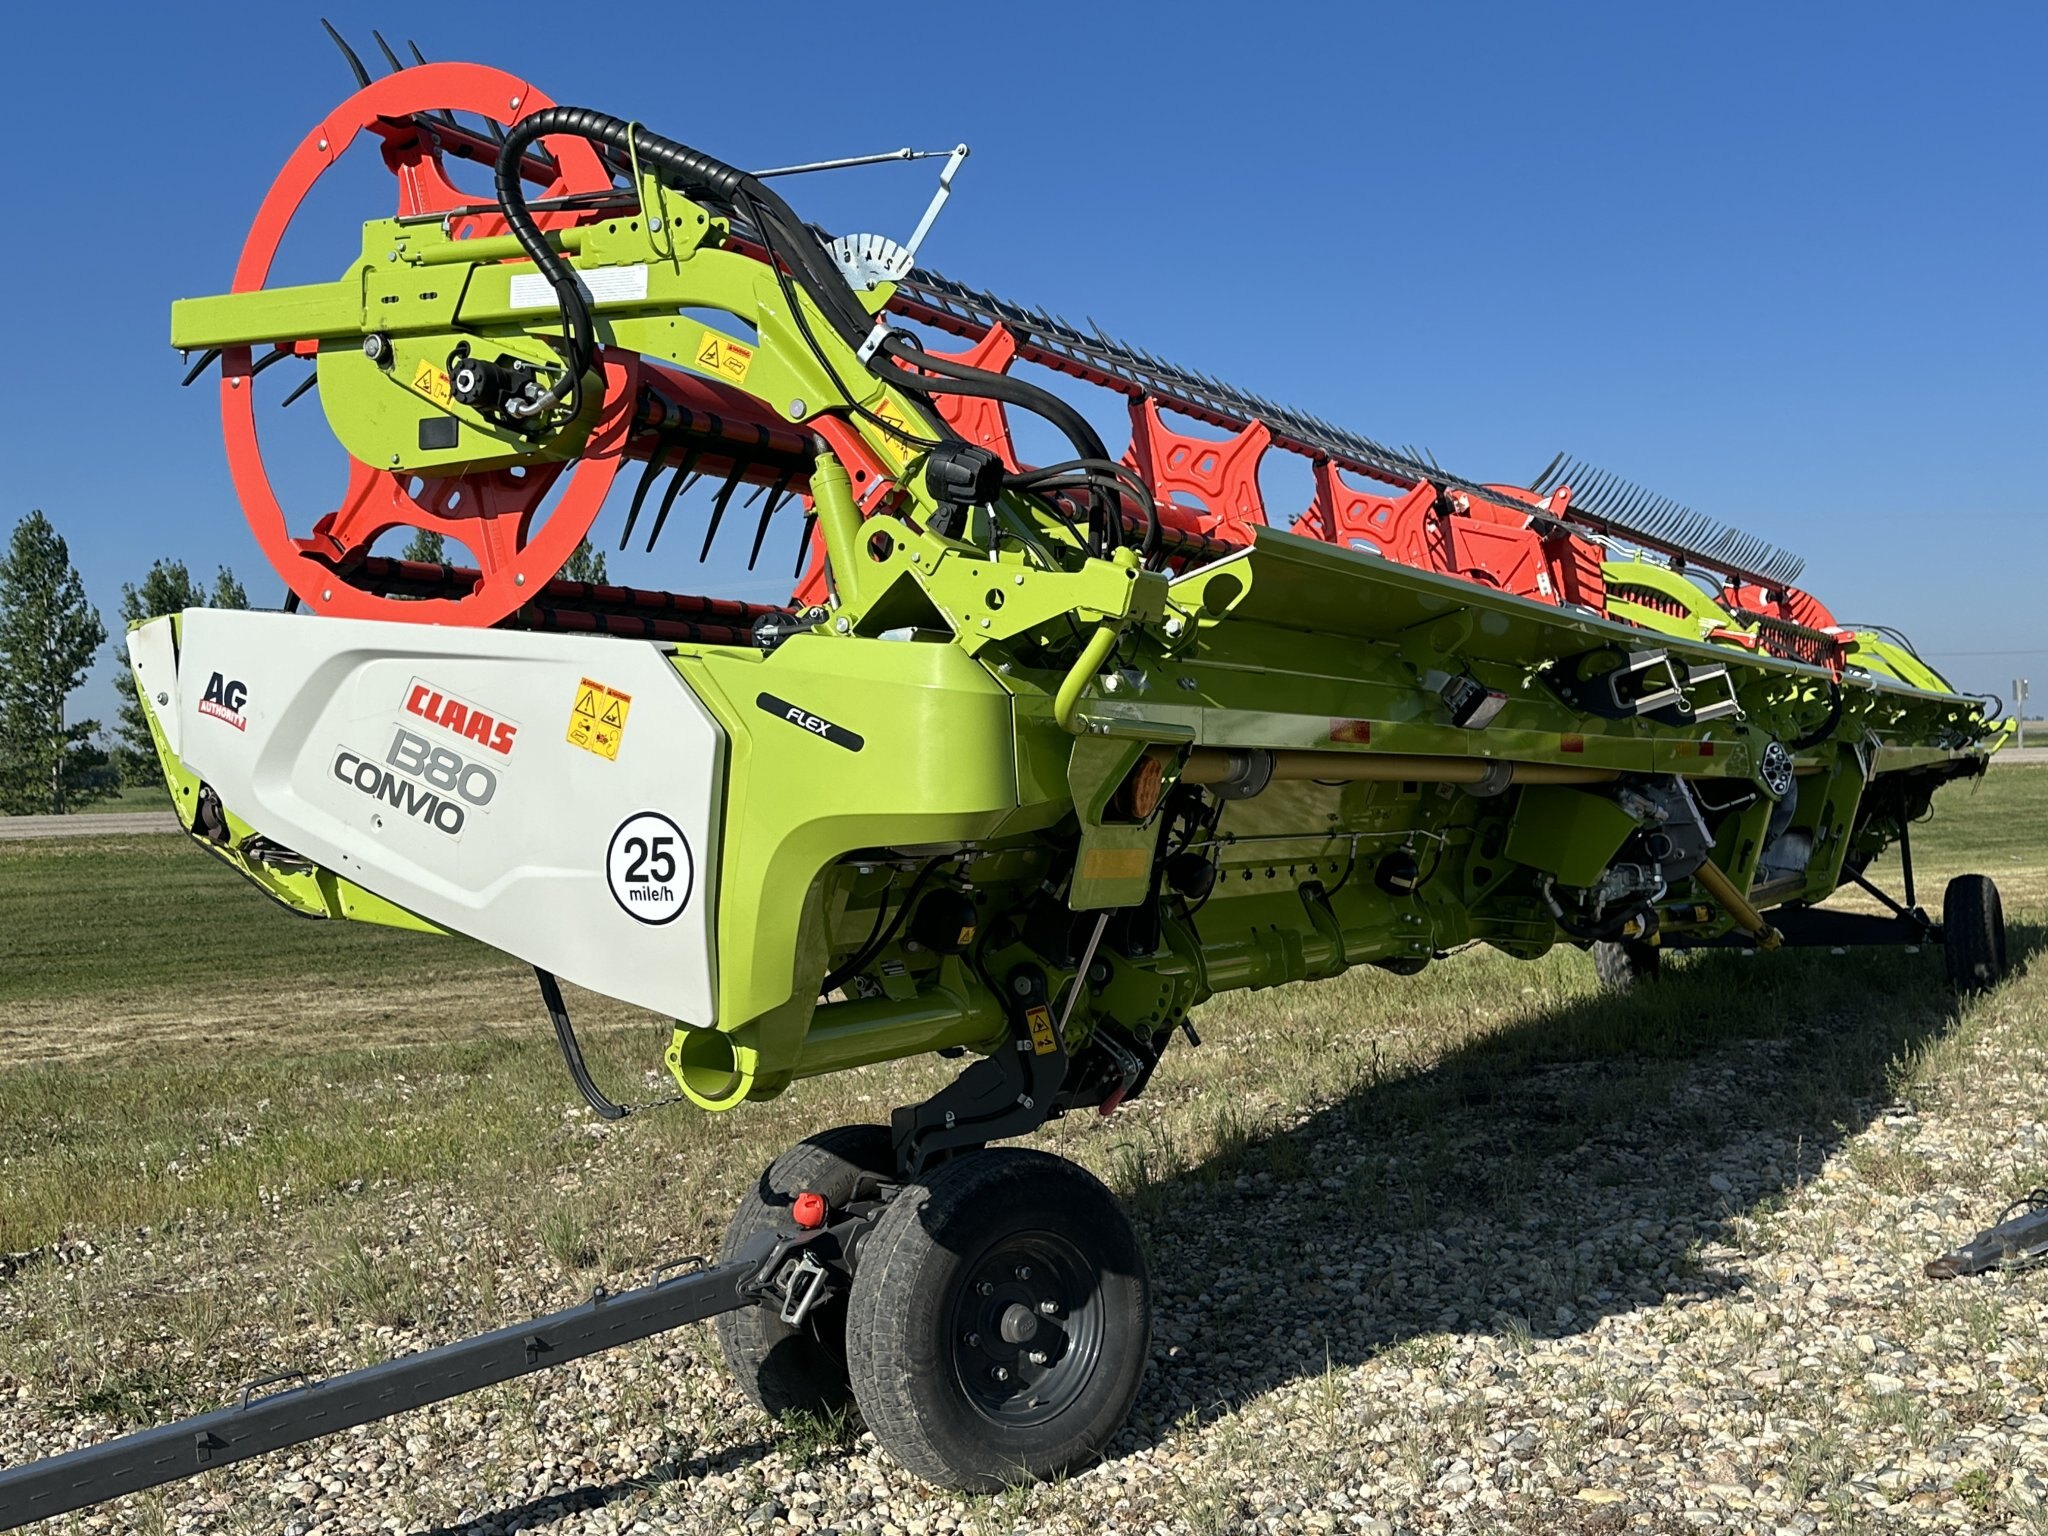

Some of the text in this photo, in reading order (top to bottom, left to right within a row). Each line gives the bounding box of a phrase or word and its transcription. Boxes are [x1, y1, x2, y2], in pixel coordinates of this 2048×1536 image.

[200, 701, 246, 728] AUTHORITY
[203, 670, 248, 714] AG
[405, 684, 518, 755] CLAAS
[785, 707, 832, 737] FLEX
[385, 727, 498, 807] B80
[333, 751, 466, 835] CONVIO
[623, 836, 676, 883] 25
[628, 885, 674, 902] mile/h
